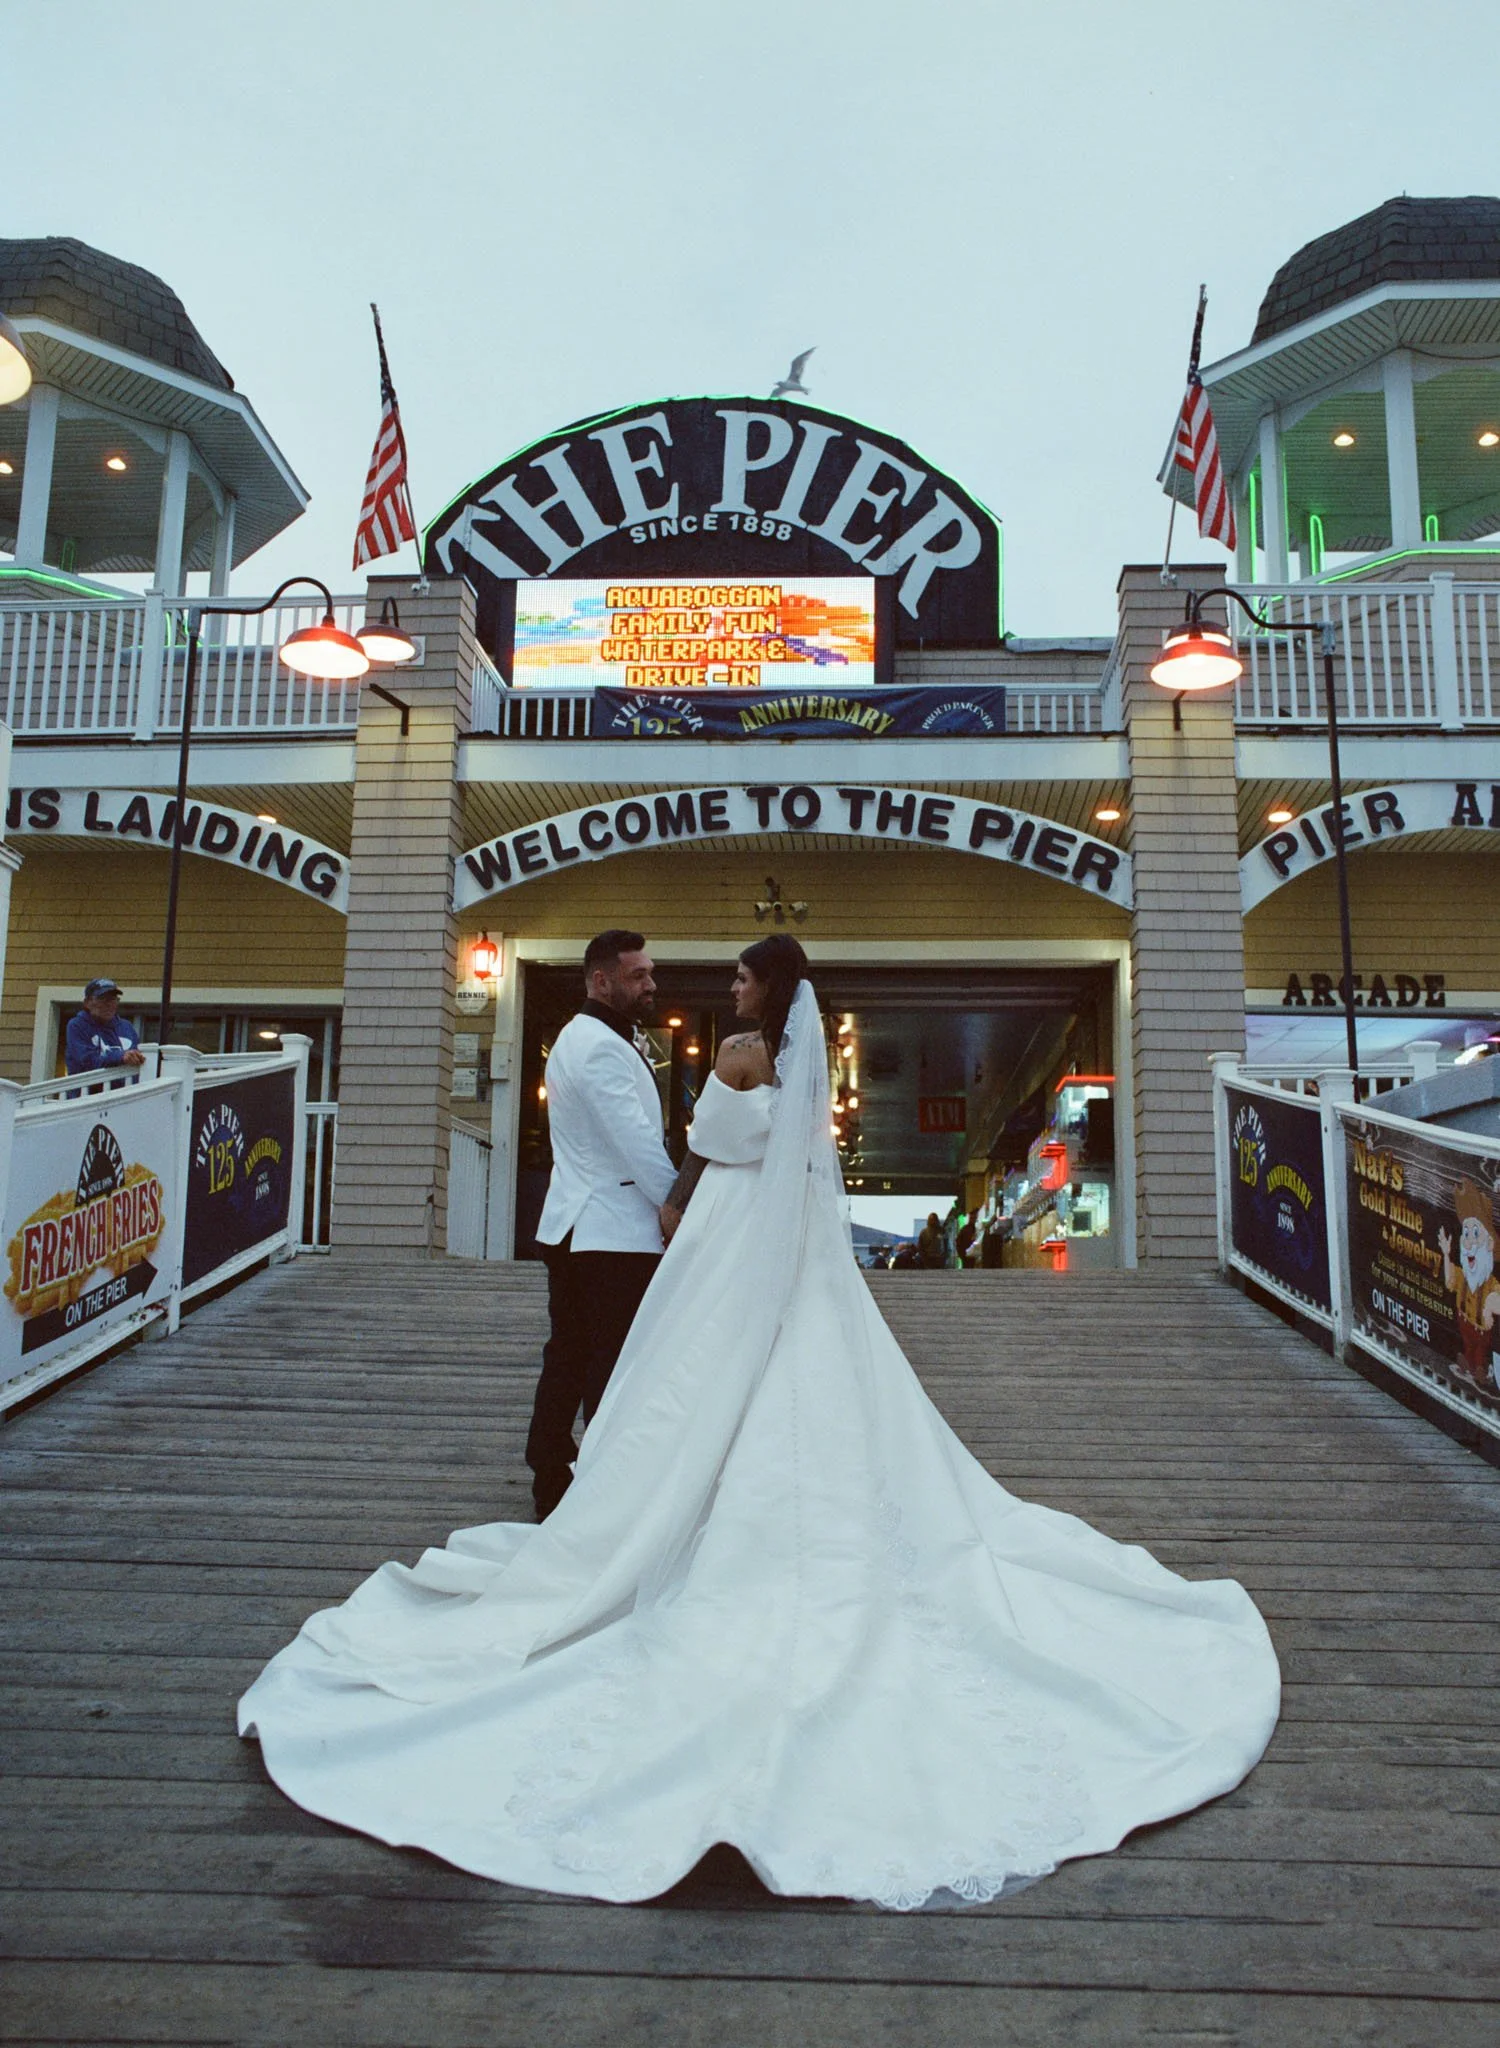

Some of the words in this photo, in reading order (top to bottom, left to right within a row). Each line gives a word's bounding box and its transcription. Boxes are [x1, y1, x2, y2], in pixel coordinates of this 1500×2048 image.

[436, 411, 680, 579] THE
[714, 409, 982, 620] PIER
[630, 514, 719, 545] SINCE
[728, 513, 793, 542] 1898
[606, 585, 782, 608] AQUABOGGAN
[612, 612, 712, 635] FAMILY
[724, 612, 778, 635] FUN
[601, 639, 765, 662] WATERPARK
[765, 639, 787, 661] &
[611, 693, 651, 729] THE
[738, 694, 896, 735] ANNIVERSARY
[921, 702, 952, 731] PROUD
[952, 701, 995, 730] PARTNER
[84, 791, 342, 899] LANDING
[464, 789, 731, 891] WELCOME
[746, 786, 822, 829] TO
[838, 788, 955, 842] THE
[968, 807, 1121, 893] PIER
[1261, 791, 1406, 877] PIER
[1451, 783, 1500, 828] A
[1282, 972, 1446, 1008] ARCADE
[207, 1137, 235, 1195] 125
[1239, 1137, 1258, 1187] 125
[1266, 1164, 1314, 1212] ANNIVERSARY
[1353, 1140, 1404, 1193] Nat's
[1359, 1181, 1387, 1217] Gold
[1389, 1194, 1424, 1235] Mine
[21, 1199, 107, 1293] FRENCH
[111, 1178, 160, 1253] FRIES
[1388, 1224, 1443, 1279] Jewelry
[65, 1300, 83, 1328] ON
[85, 1289, 105, 1318] THE
[106, 1276, 128, 1306] PIER
[1371, 1260, 1382, 1279] for
[1382, 1271, 1399, 1290] your
[1399, 1281, 1416, 1300] own
[1416, 1290, 1454, 1321] treasure
[1406, 1269, 1421, 1287] and
[1422, 1277, 1444, 1298] mine
[1372, 1287, 1386, 1315] ON
[1386, 1296, 1405, 1327] THE
[1406, 1309, 1431, 1342] PIER
